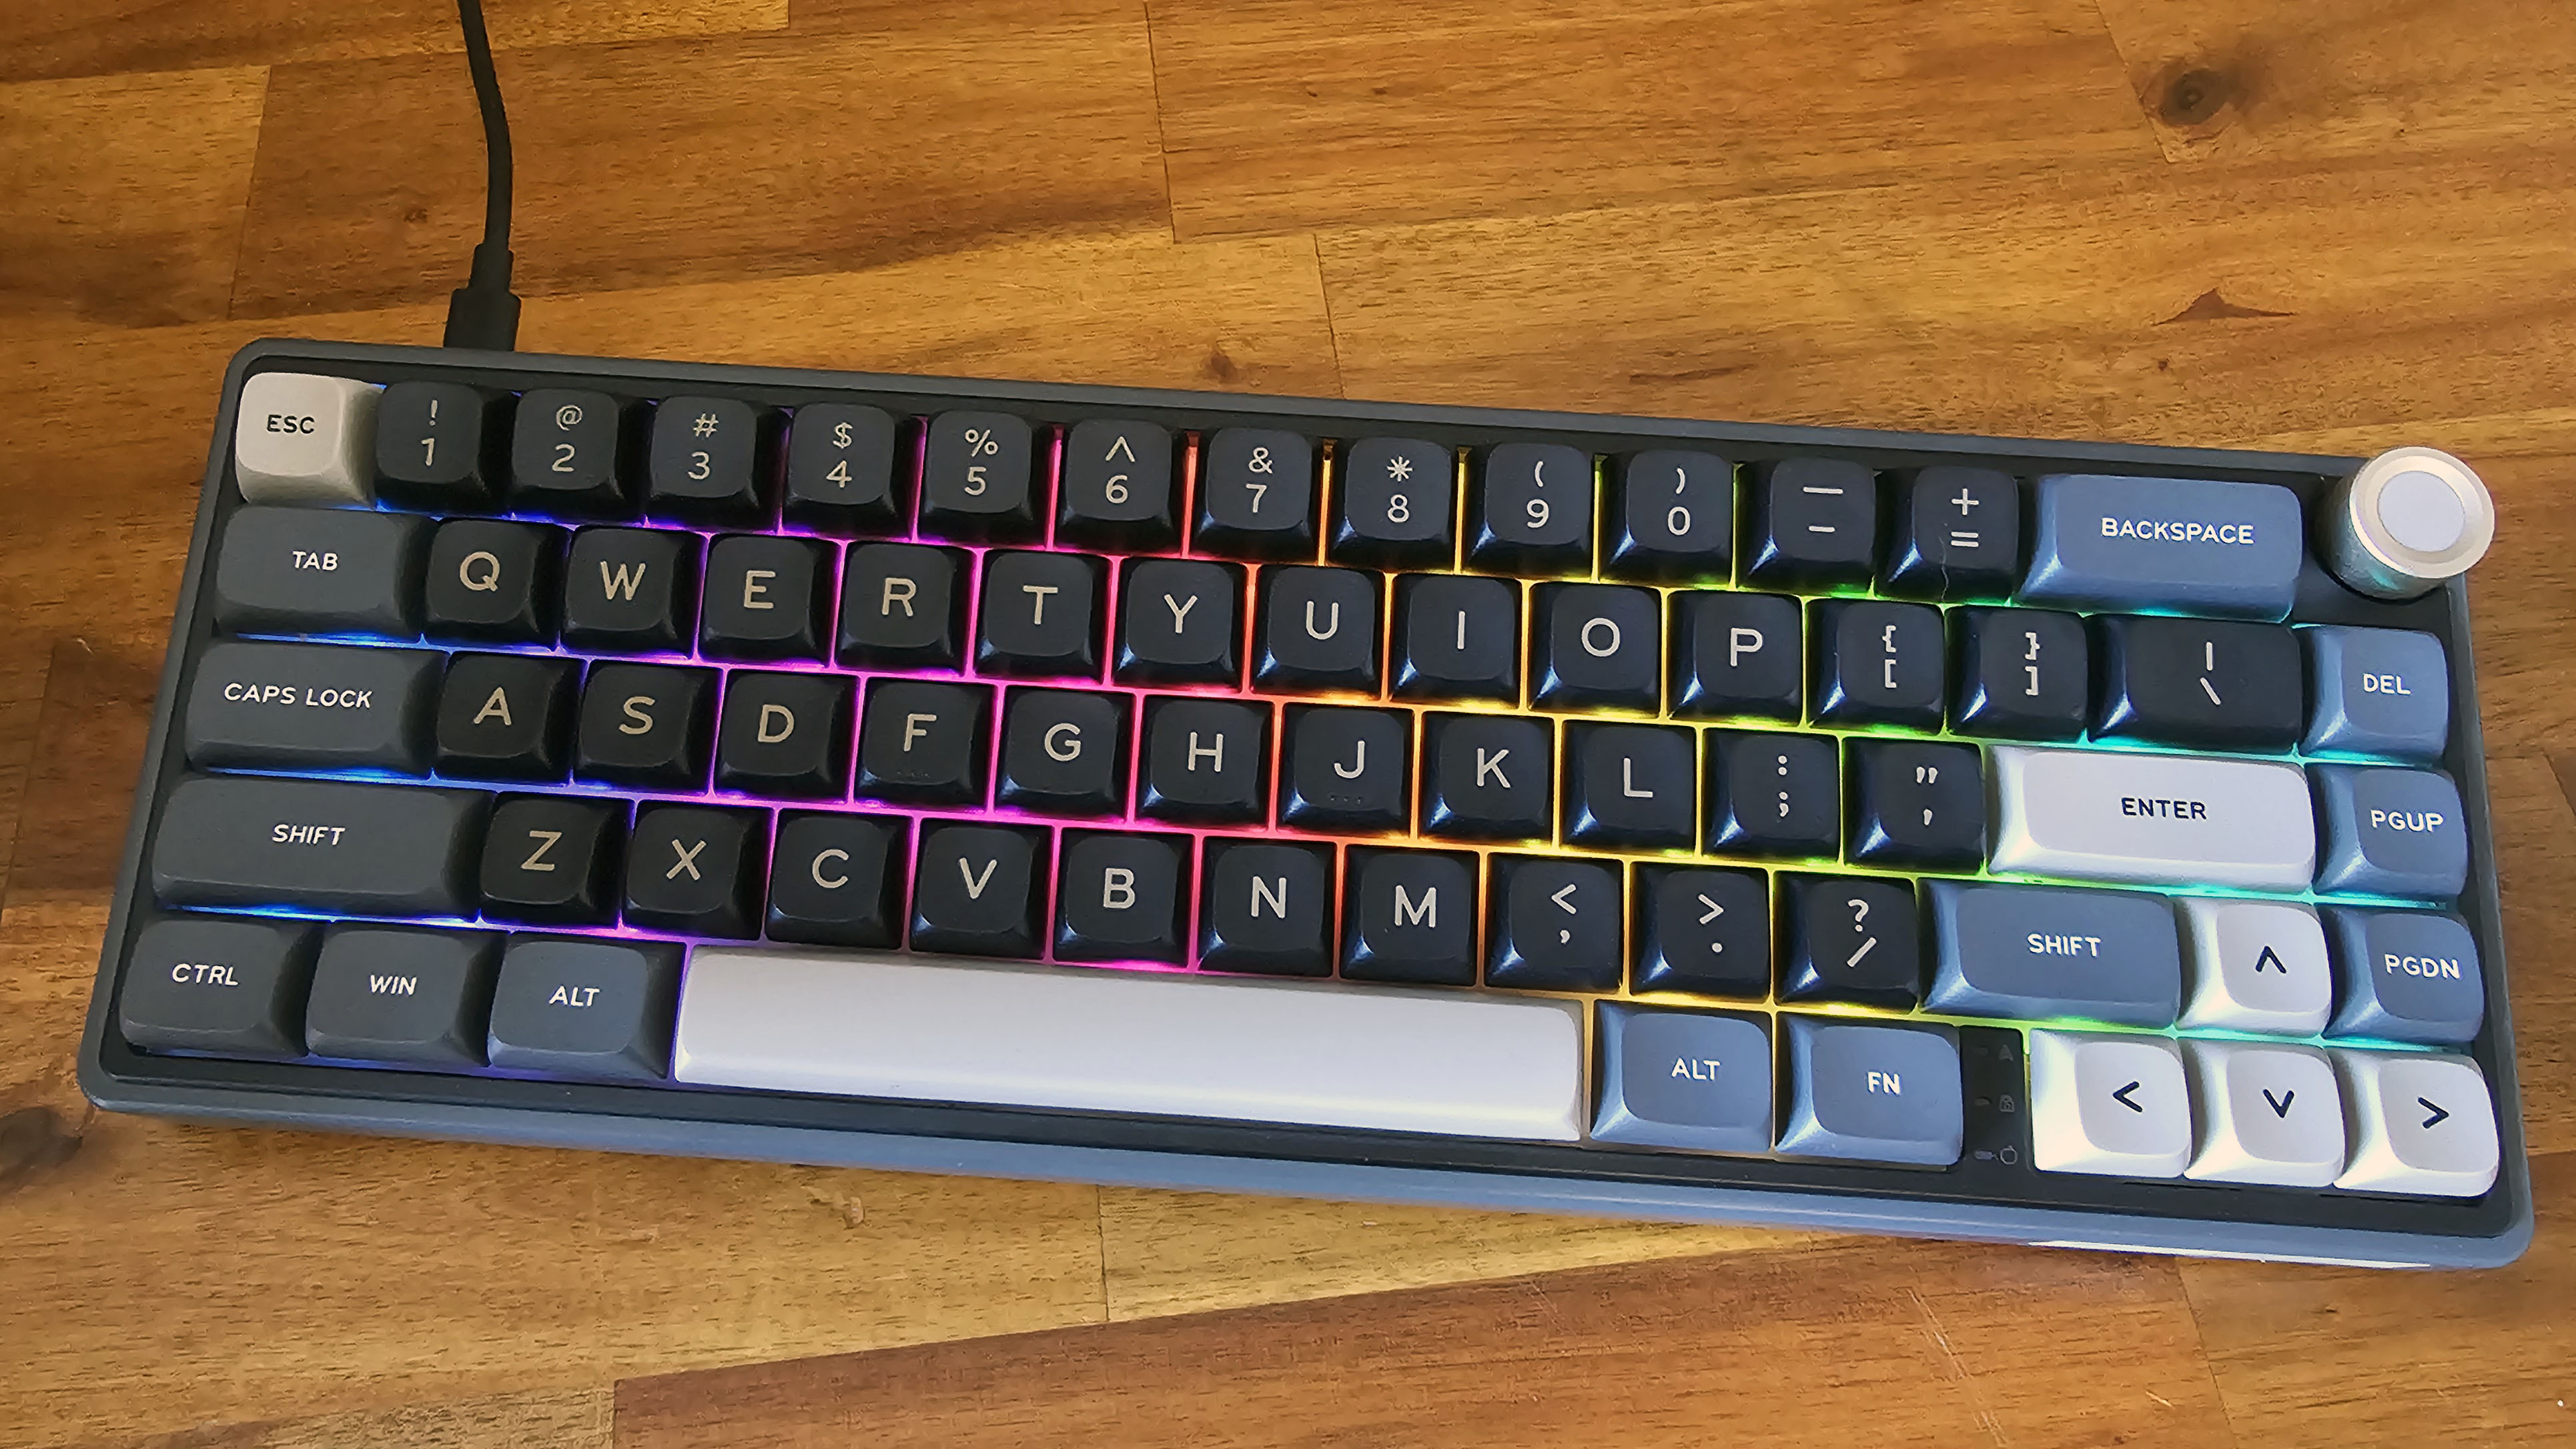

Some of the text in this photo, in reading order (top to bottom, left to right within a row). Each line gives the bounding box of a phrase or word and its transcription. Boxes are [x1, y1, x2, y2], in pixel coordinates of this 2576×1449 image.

[266, 414, 316, 435] ESC
[555, 404, 583, 432] @
[692, 412, 720, 438] #
[832, 421, 853, 450] $
[964, 428, 999, 458] %
[420, 437, 436, 467] 1
[551, 443, 576, 472] 2
[687, 451, 711, 480] 3
[1248, 446, 1274, 474] &
[825, 460, 853, 488] 4
[963, 466, 987, 496] 5
[1105, 474, 1129, 504] 6
[1245, 482, 1268, 514] 7
[1387, 494, 1410, 524] 8
[1950, 487, 1980, 516] +
[1526, 498, 1550, 529] 9
[1667, 506, 1691, 536] 0
[1950, 530, 1980, 548] =
[2101, 516, 2255, 545] BACKSPACE
[292, 550, 338, 572] TAB
[458, 550, 500, 592] Q
[599, 560, 647, 601] W
[743, 569, 777, 610] E
[881, 576, 917, 618] R
[1022, 584, 1059, 626] T
[1163, 593, 1198, 634] Y
[1305, 600, 1340, 640] U
[1581, 617, 1621, 658] O
[1729, 626, 1764, 667] P
[1881, 624, 1897, 654] {
[2024, 631, 2041, 661] }
[1884, 658, 1897, 689] [
[2024, 665, 2040, 696] ]
[2363, 672, 2412, 695] DEL
[224, 682, 373, 709] CAPS LOCK
[2199, 676, 2222, 706] \
[472, 686, 512, 727] A
[618, 695, 656, 735] S
[757, 703, 795, 744] D
[903, 712, 938, 753] F
[1043, 722, 1082, 762] G
[1187, 731, 1224, 773] H
[1333, 740, 1366, 779] J
[1476, 747, 1512, 789] K
[1623, 757, 1654, 799] L
[2120, 795, 2209, 822] ENTER
[2370, 809, 2445, 833] PGUP
[272, 823, 346, 846] SHIFT
[520, 829, 563, 872] Z
[665, 838, 707, 881] X
[811, 848, 850, 889] C
[958, 857, 998, 900] V
[1102, 867, 1136, 910] B
[1250, 875, 1288, 919] N
[1551, 883, 1577, 915] <
[1394, 884, 1437, 929] M
[1697, 893, 1725, 925] >
[1847, 898, 1869, 933] ?
[1846, 936, 1877, 968] /
[2026, 933, 2102, 957] SHIFT
[171, 963, 239, 987] CTRL
[2384, 953, 2461, 979] PGDN
[370, 974, 418, 996] WIN
[548, 985, 600, 1007] ALT
[1671, 1057, 1721, 1081] ALT
[1867, 1071, 1901, 1095] FN
